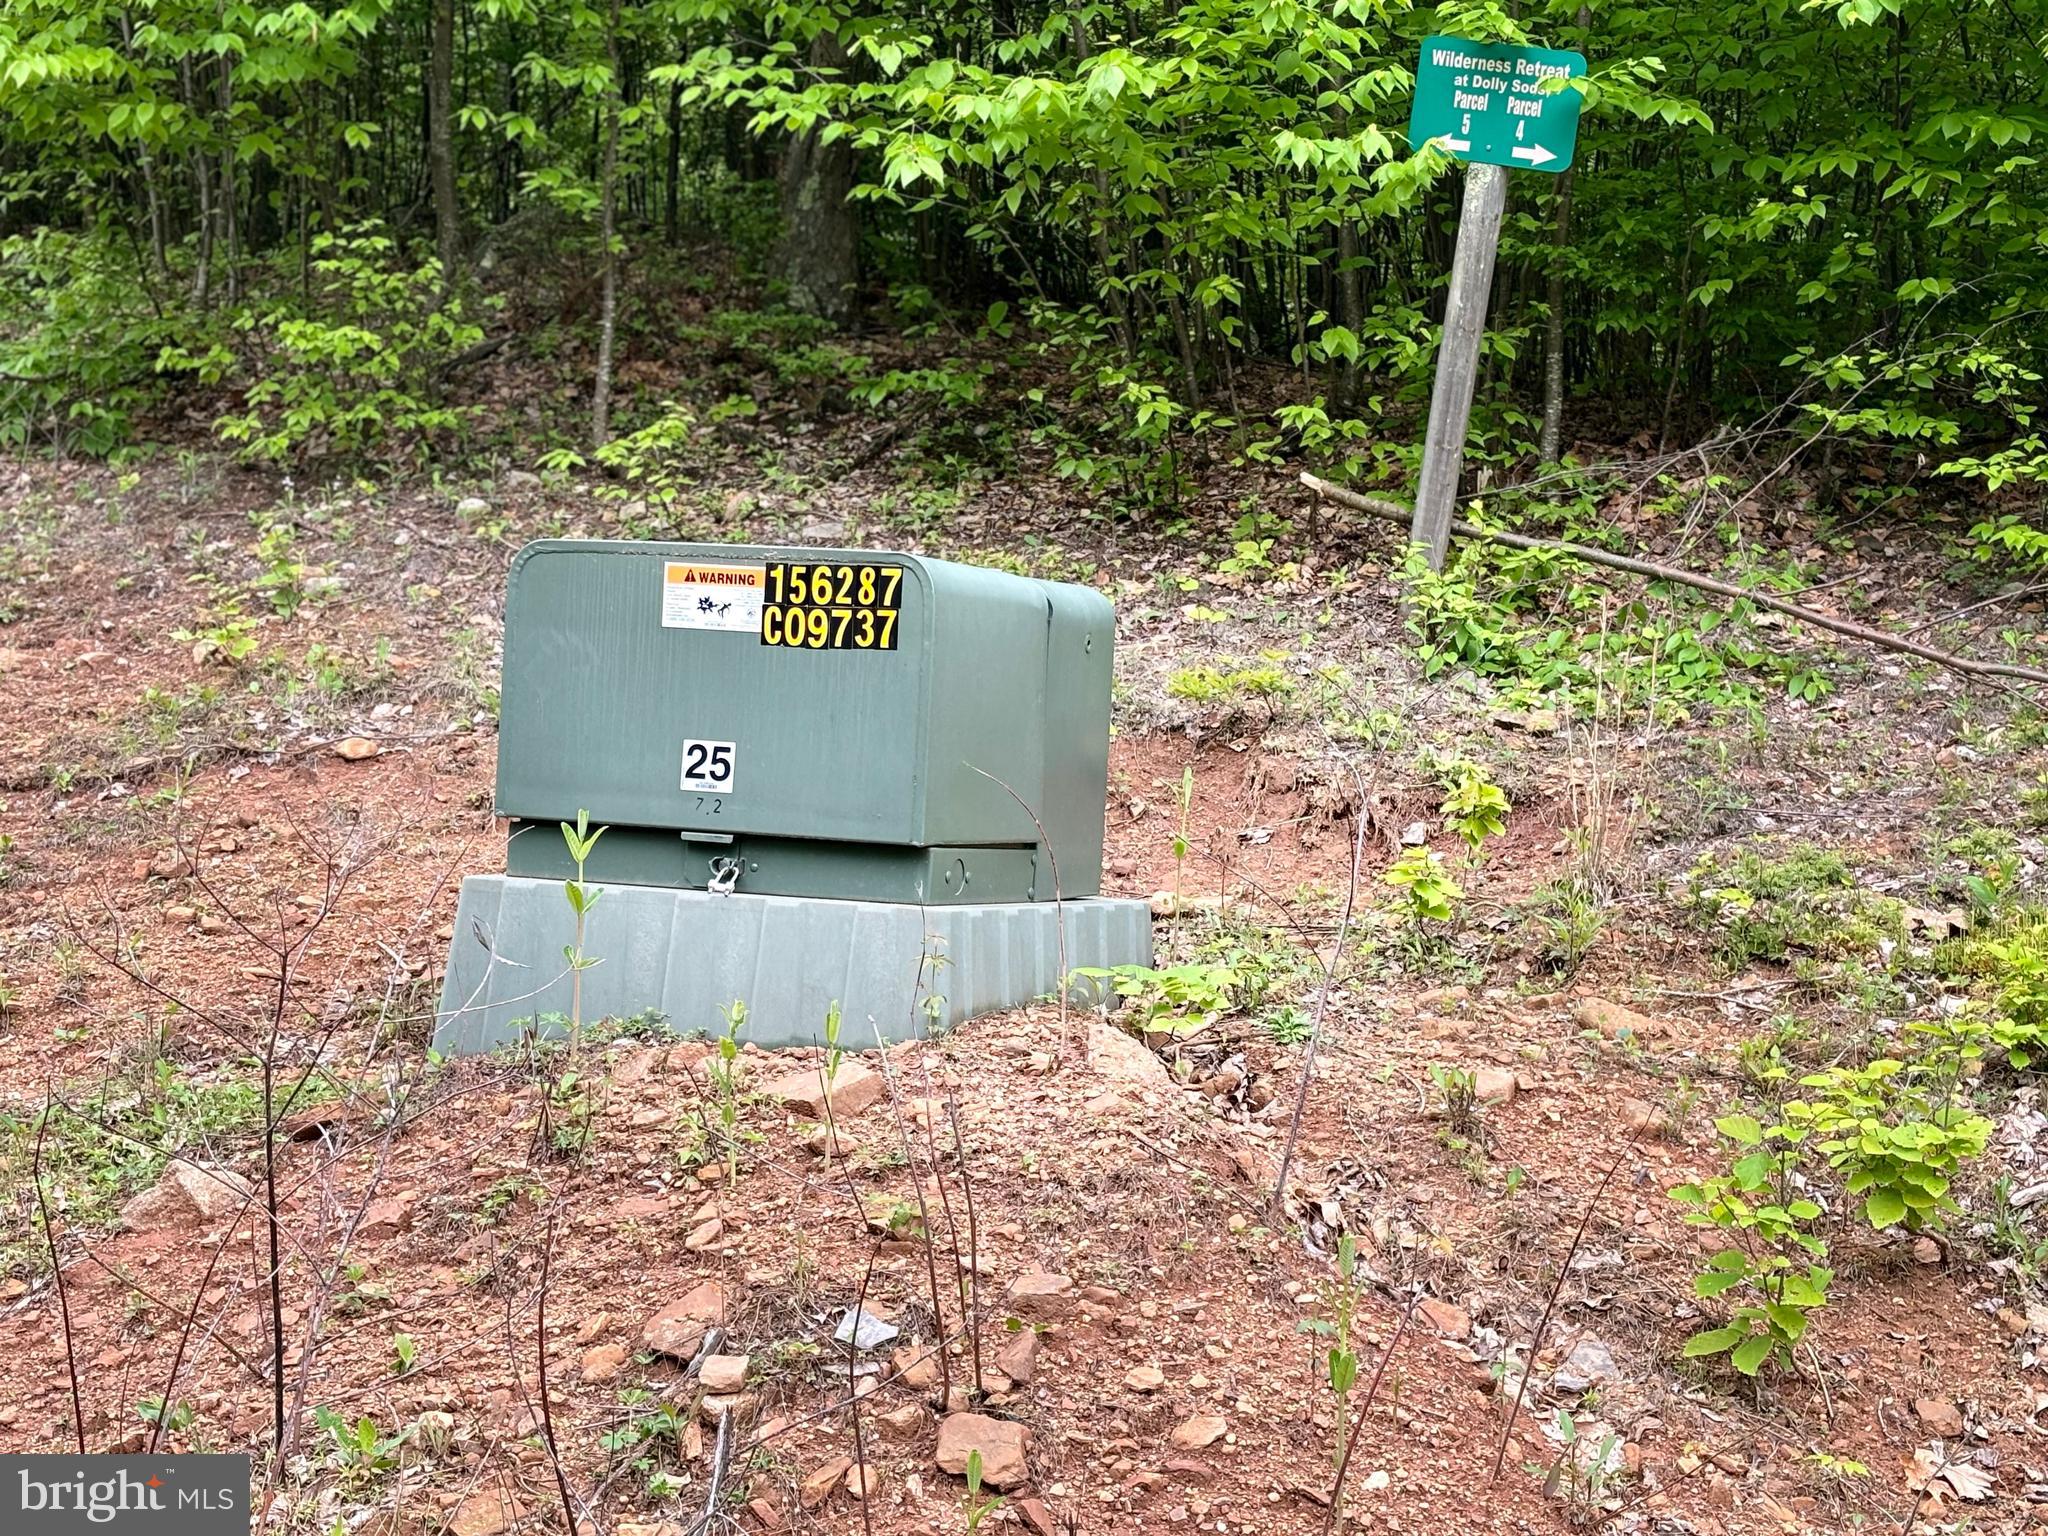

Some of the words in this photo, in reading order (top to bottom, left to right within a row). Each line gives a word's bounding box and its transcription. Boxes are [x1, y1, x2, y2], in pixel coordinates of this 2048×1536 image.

[1432, 49, 1511, 73] Wilderness
[1516, 59, 1571, 79] Retreat
[1454, 75, 1468, 87] at
[1472, 76, 1508, 93] Dolly
[1453, 90, 1489, 112] Parcel
[1506, 96, 1542, 117] Parcel
[1461, 113, 1471, 134] 5
[1515, 120, 1525, 141] 4
[699, 572, 755, 586] WARNING
[769, 564, 903, 607] 156287
[685, 744, 731, 782] 25
[695, 797, 723, 815] 7.2
